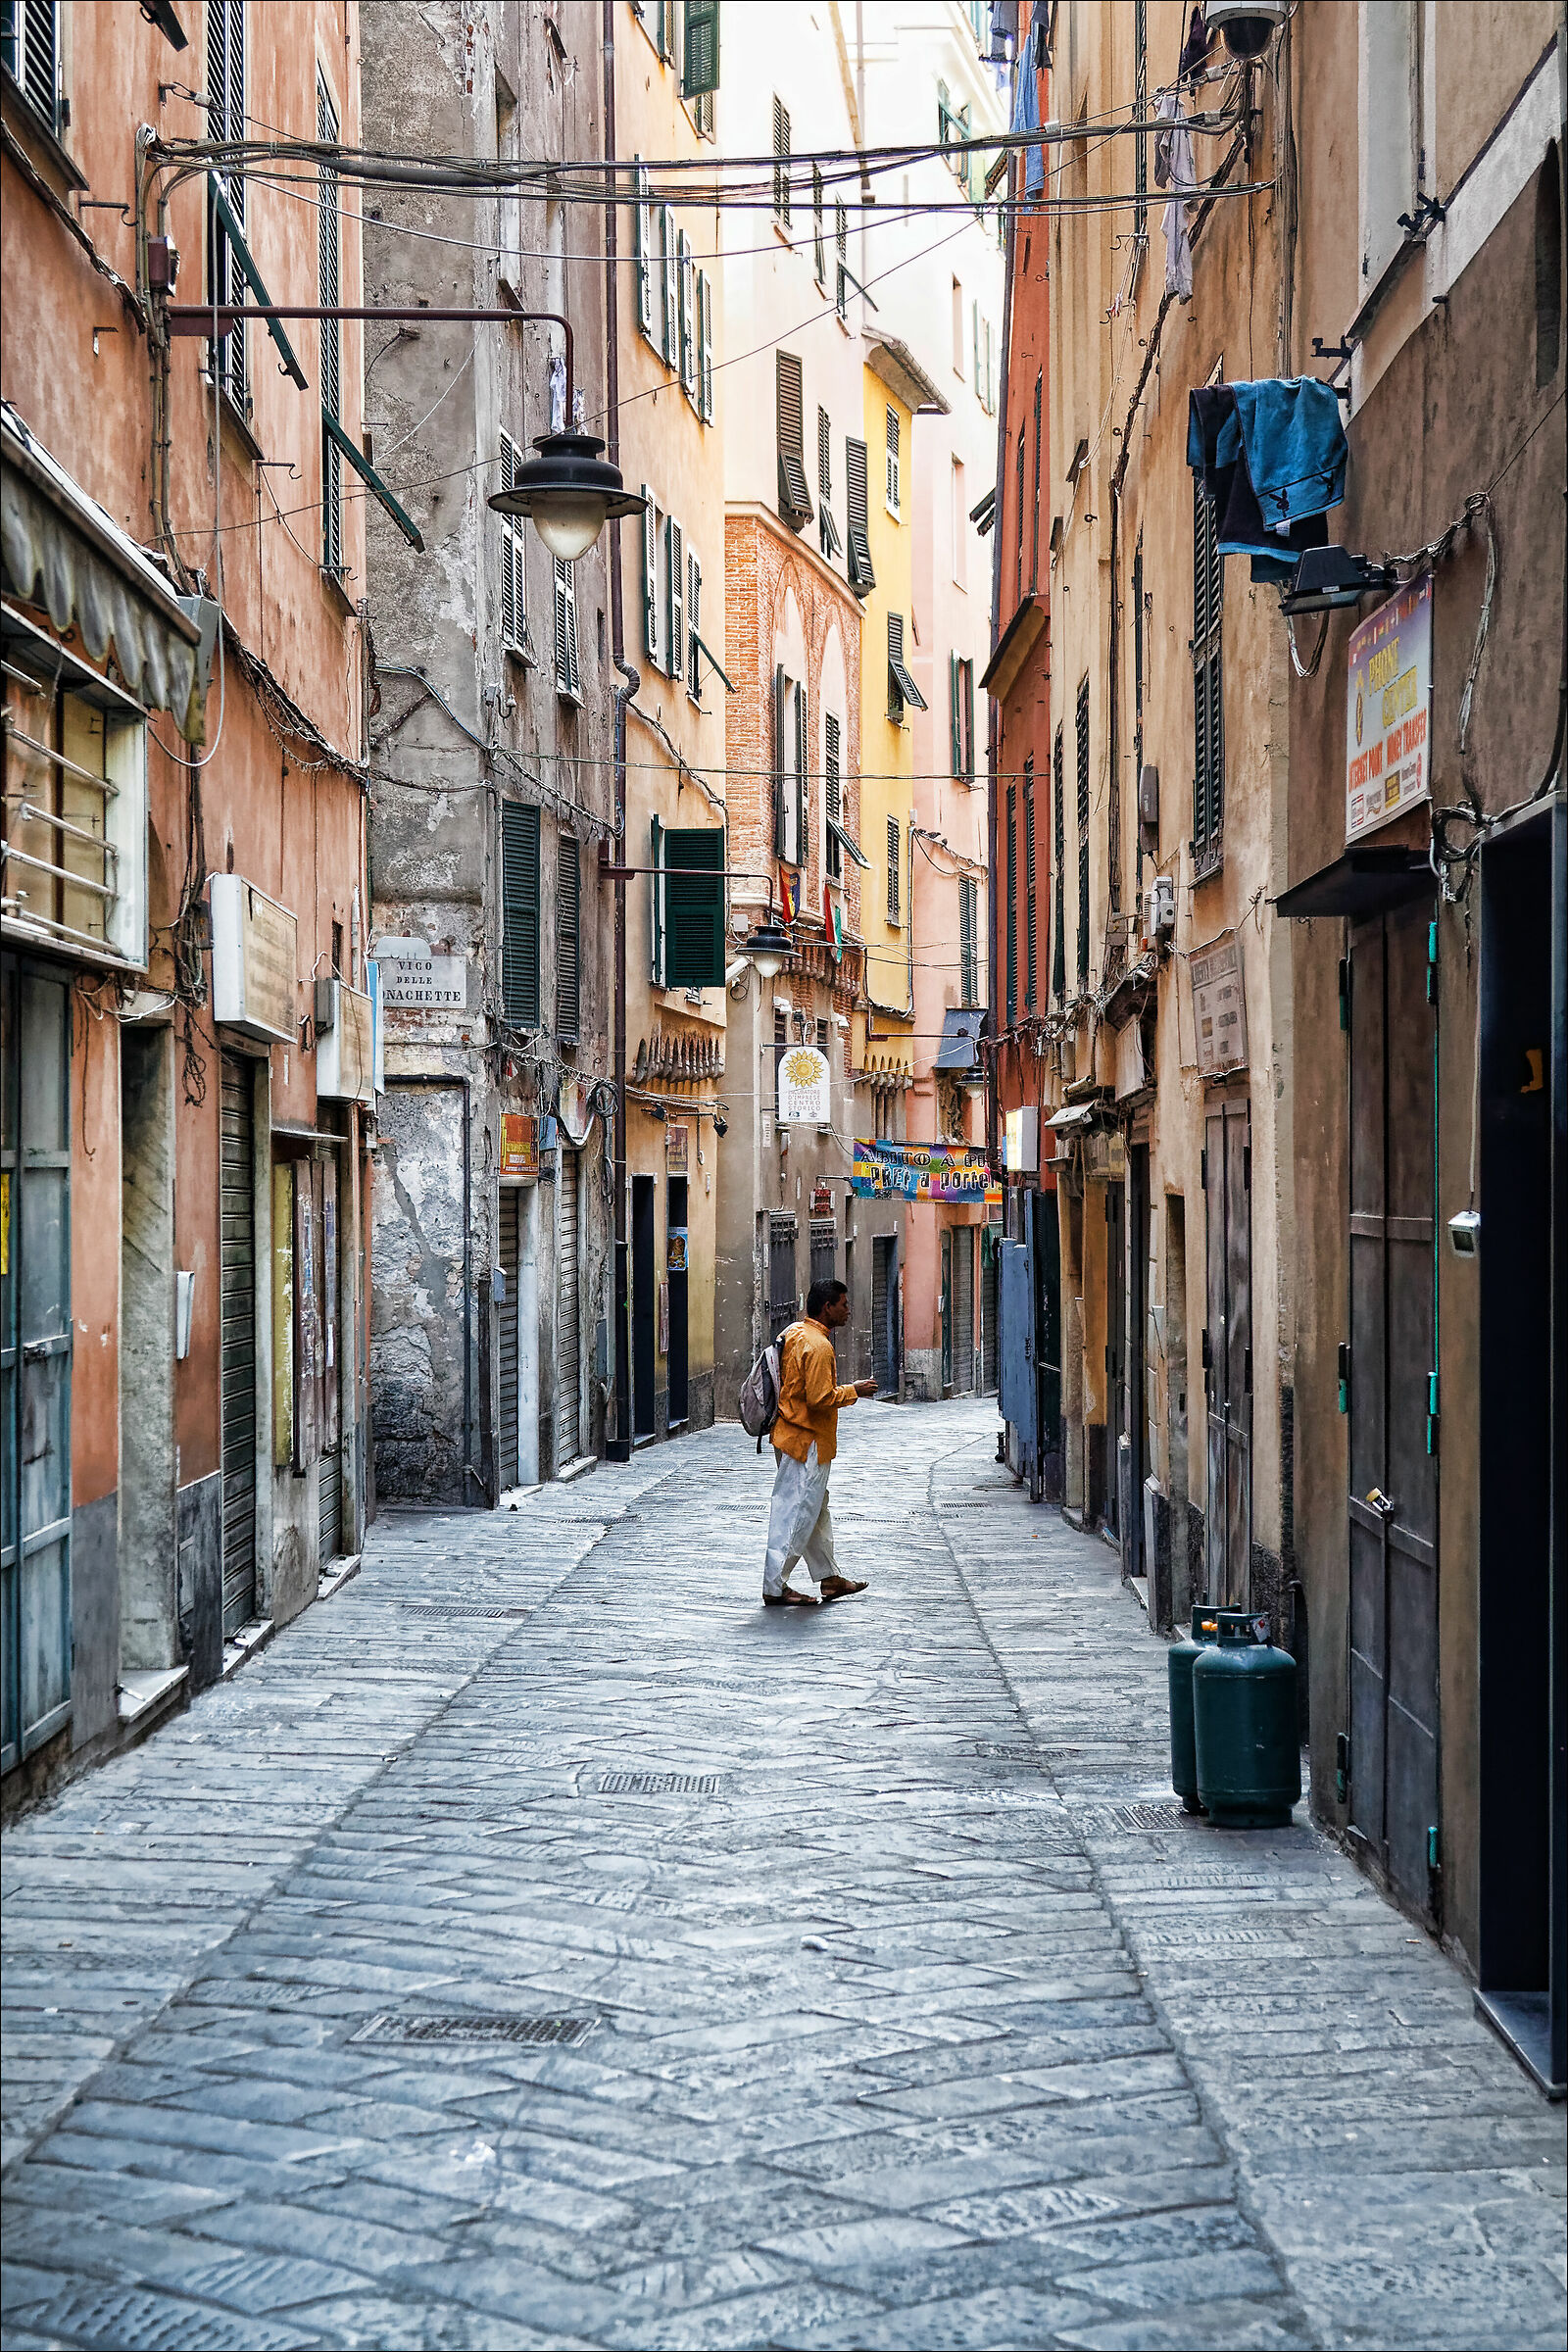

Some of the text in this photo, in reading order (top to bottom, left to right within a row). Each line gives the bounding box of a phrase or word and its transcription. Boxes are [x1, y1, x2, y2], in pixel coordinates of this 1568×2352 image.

[1368, 636, 1399, 697] PHONE
[1382, 664, 1418, 729] CENTER
[1386, 707, 1427, 768] MONEY TRANSFER
[1369, 740, 1384, 780] POINT
[396, 975, 432, 985] DELLE
[398, 960, 432, 971] VICO
[382, 989, 462, 1002] NACHETTE
[860, 1149, 931, 1166] ABITO
[940, 1152, 956, 1167] A
